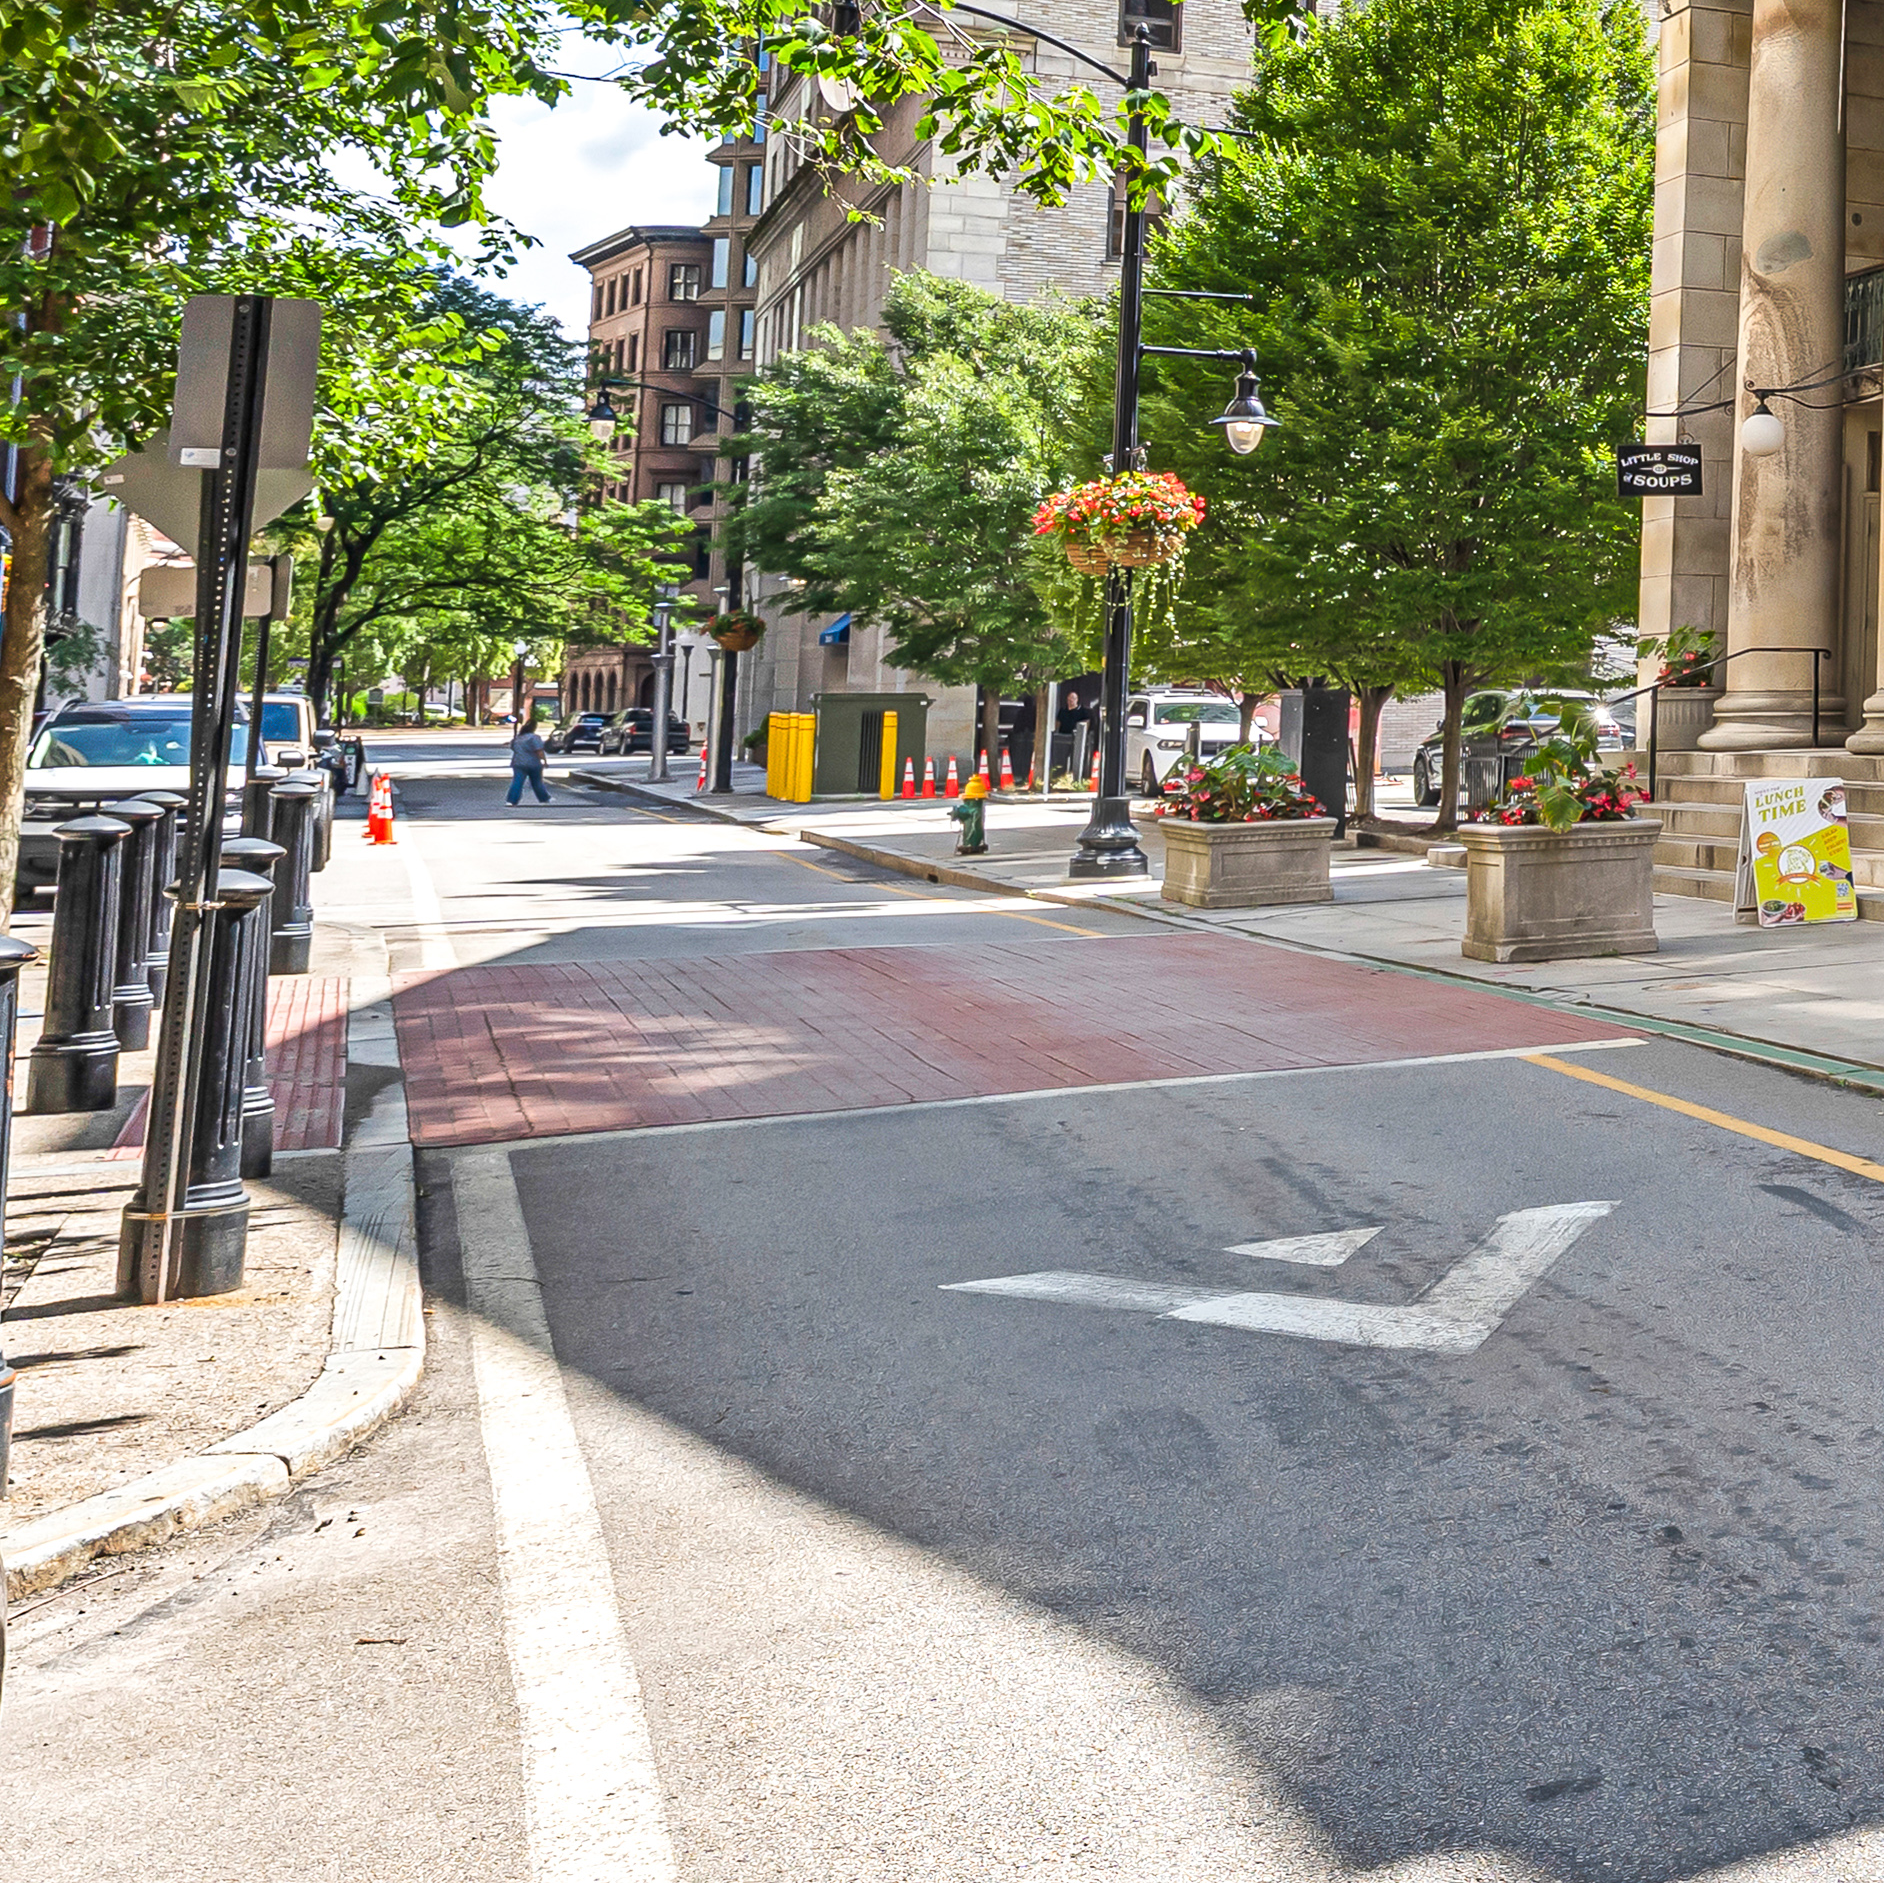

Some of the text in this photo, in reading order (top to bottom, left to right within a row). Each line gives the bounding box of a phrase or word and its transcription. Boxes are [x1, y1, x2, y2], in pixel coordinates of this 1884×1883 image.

[1620, 452, 1699, 467] LITTLE SHOP
[1633, 473, 1693, 488] SOUPS
[1755, 785, 1804, 809] LUNCH
[1758, 799, 1807, 823] TIME
